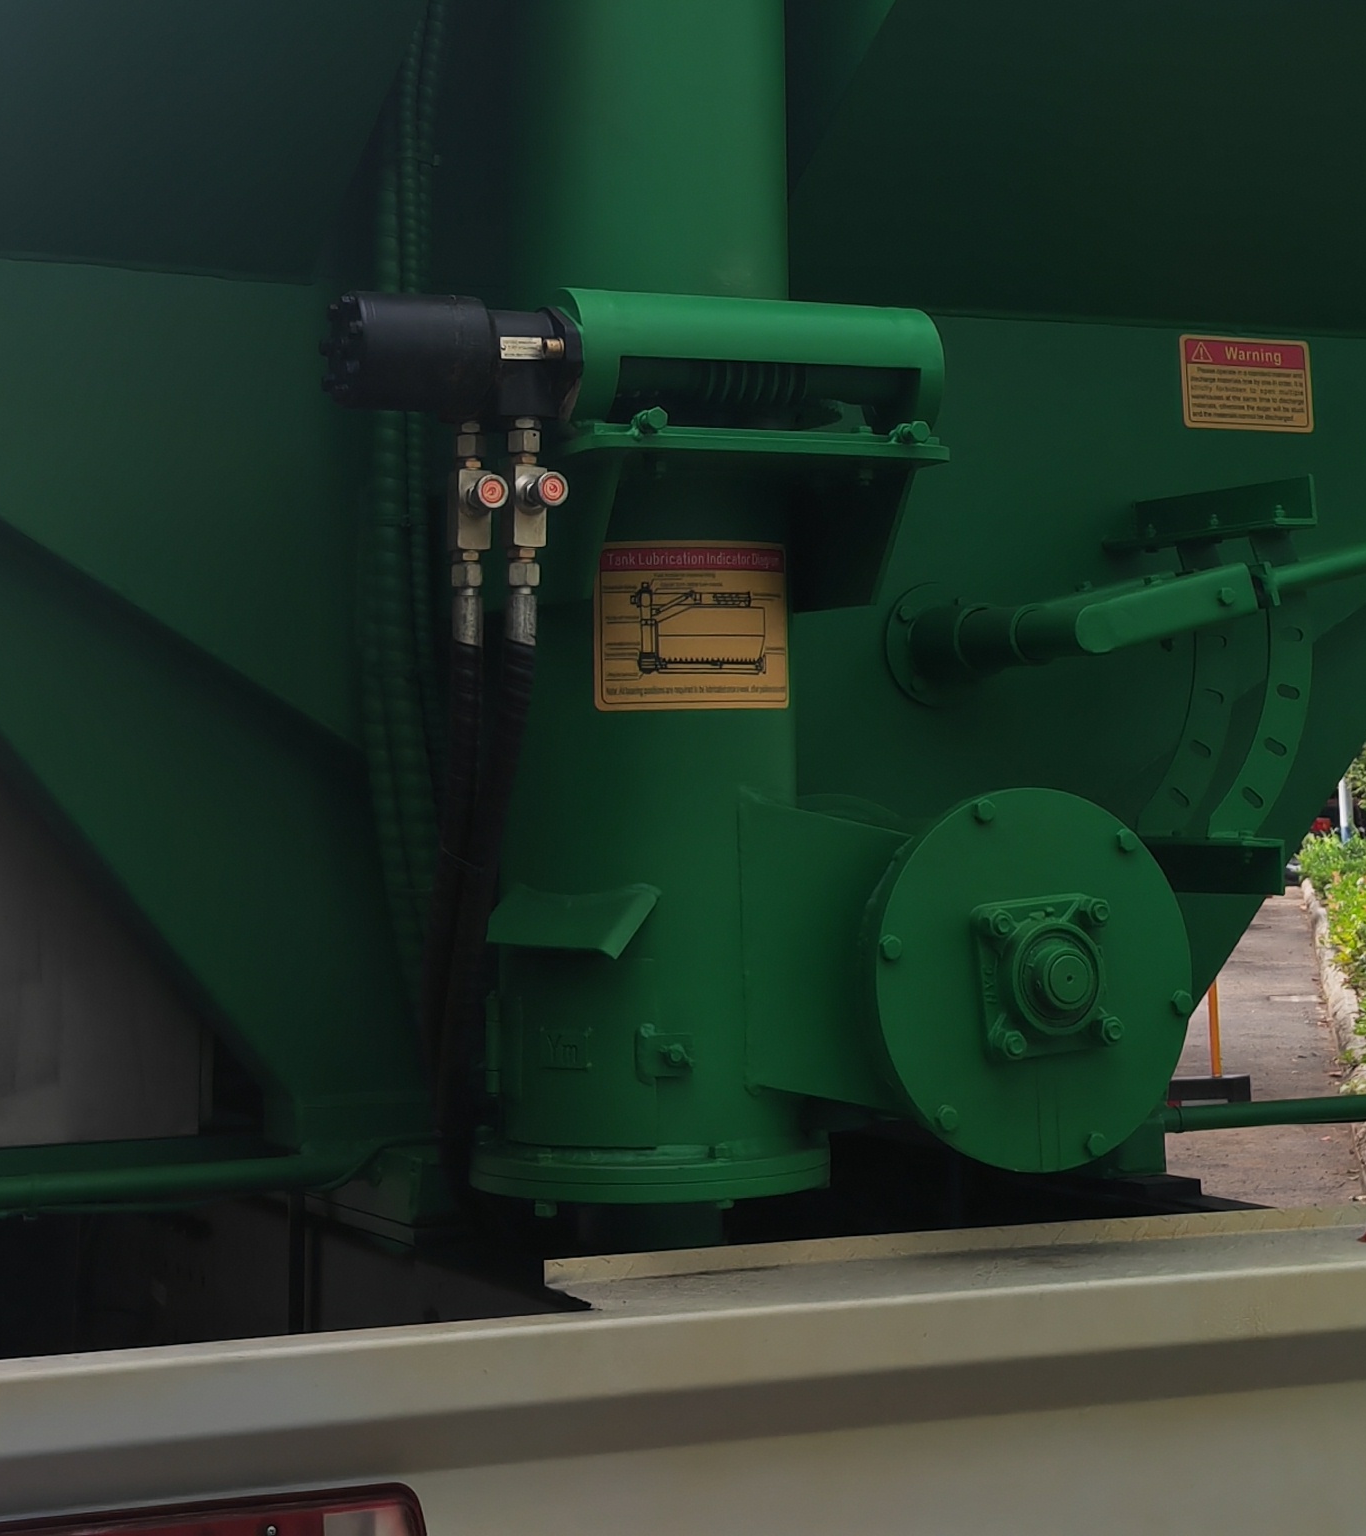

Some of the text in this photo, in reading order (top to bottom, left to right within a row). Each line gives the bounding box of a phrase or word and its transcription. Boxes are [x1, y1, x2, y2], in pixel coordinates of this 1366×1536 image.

[1225, 345, 1282, 366] Warning
[607, 553, 636, 566] Tank
[638, 552, 705, 566] Lubrication
[706, 552, 751, 566] Indicator
